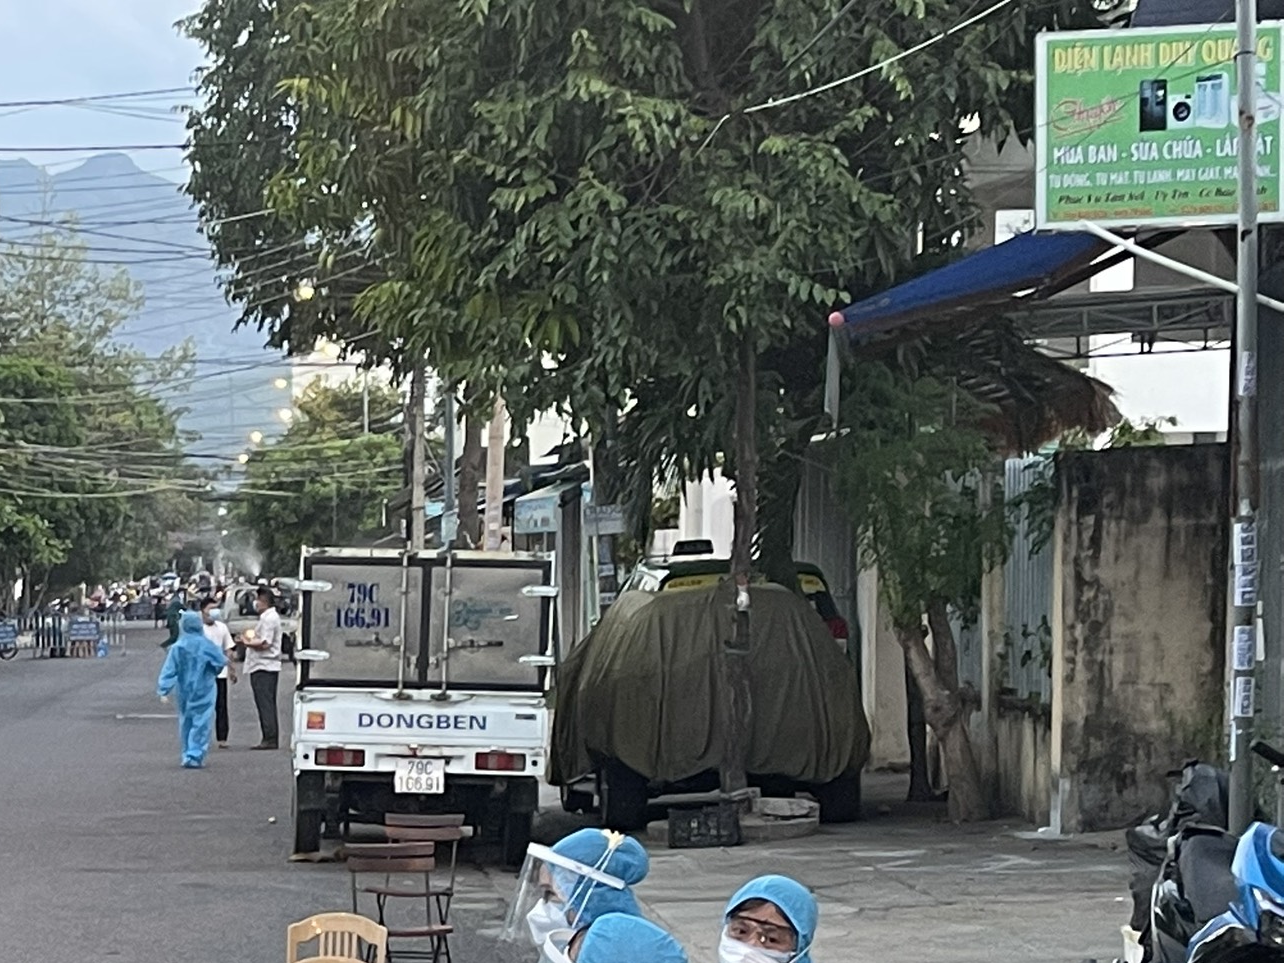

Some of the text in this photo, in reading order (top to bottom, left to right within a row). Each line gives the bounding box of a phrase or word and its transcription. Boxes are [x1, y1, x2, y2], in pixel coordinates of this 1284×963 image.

[1201, 36, 1274, 66] QUAG
[347, 583, 380, 603] 79C
[336, 607, 390, 629] 166.91
[358, 713, 487, 731] DONGBEN
[407, 760, 433, 776] 79C
